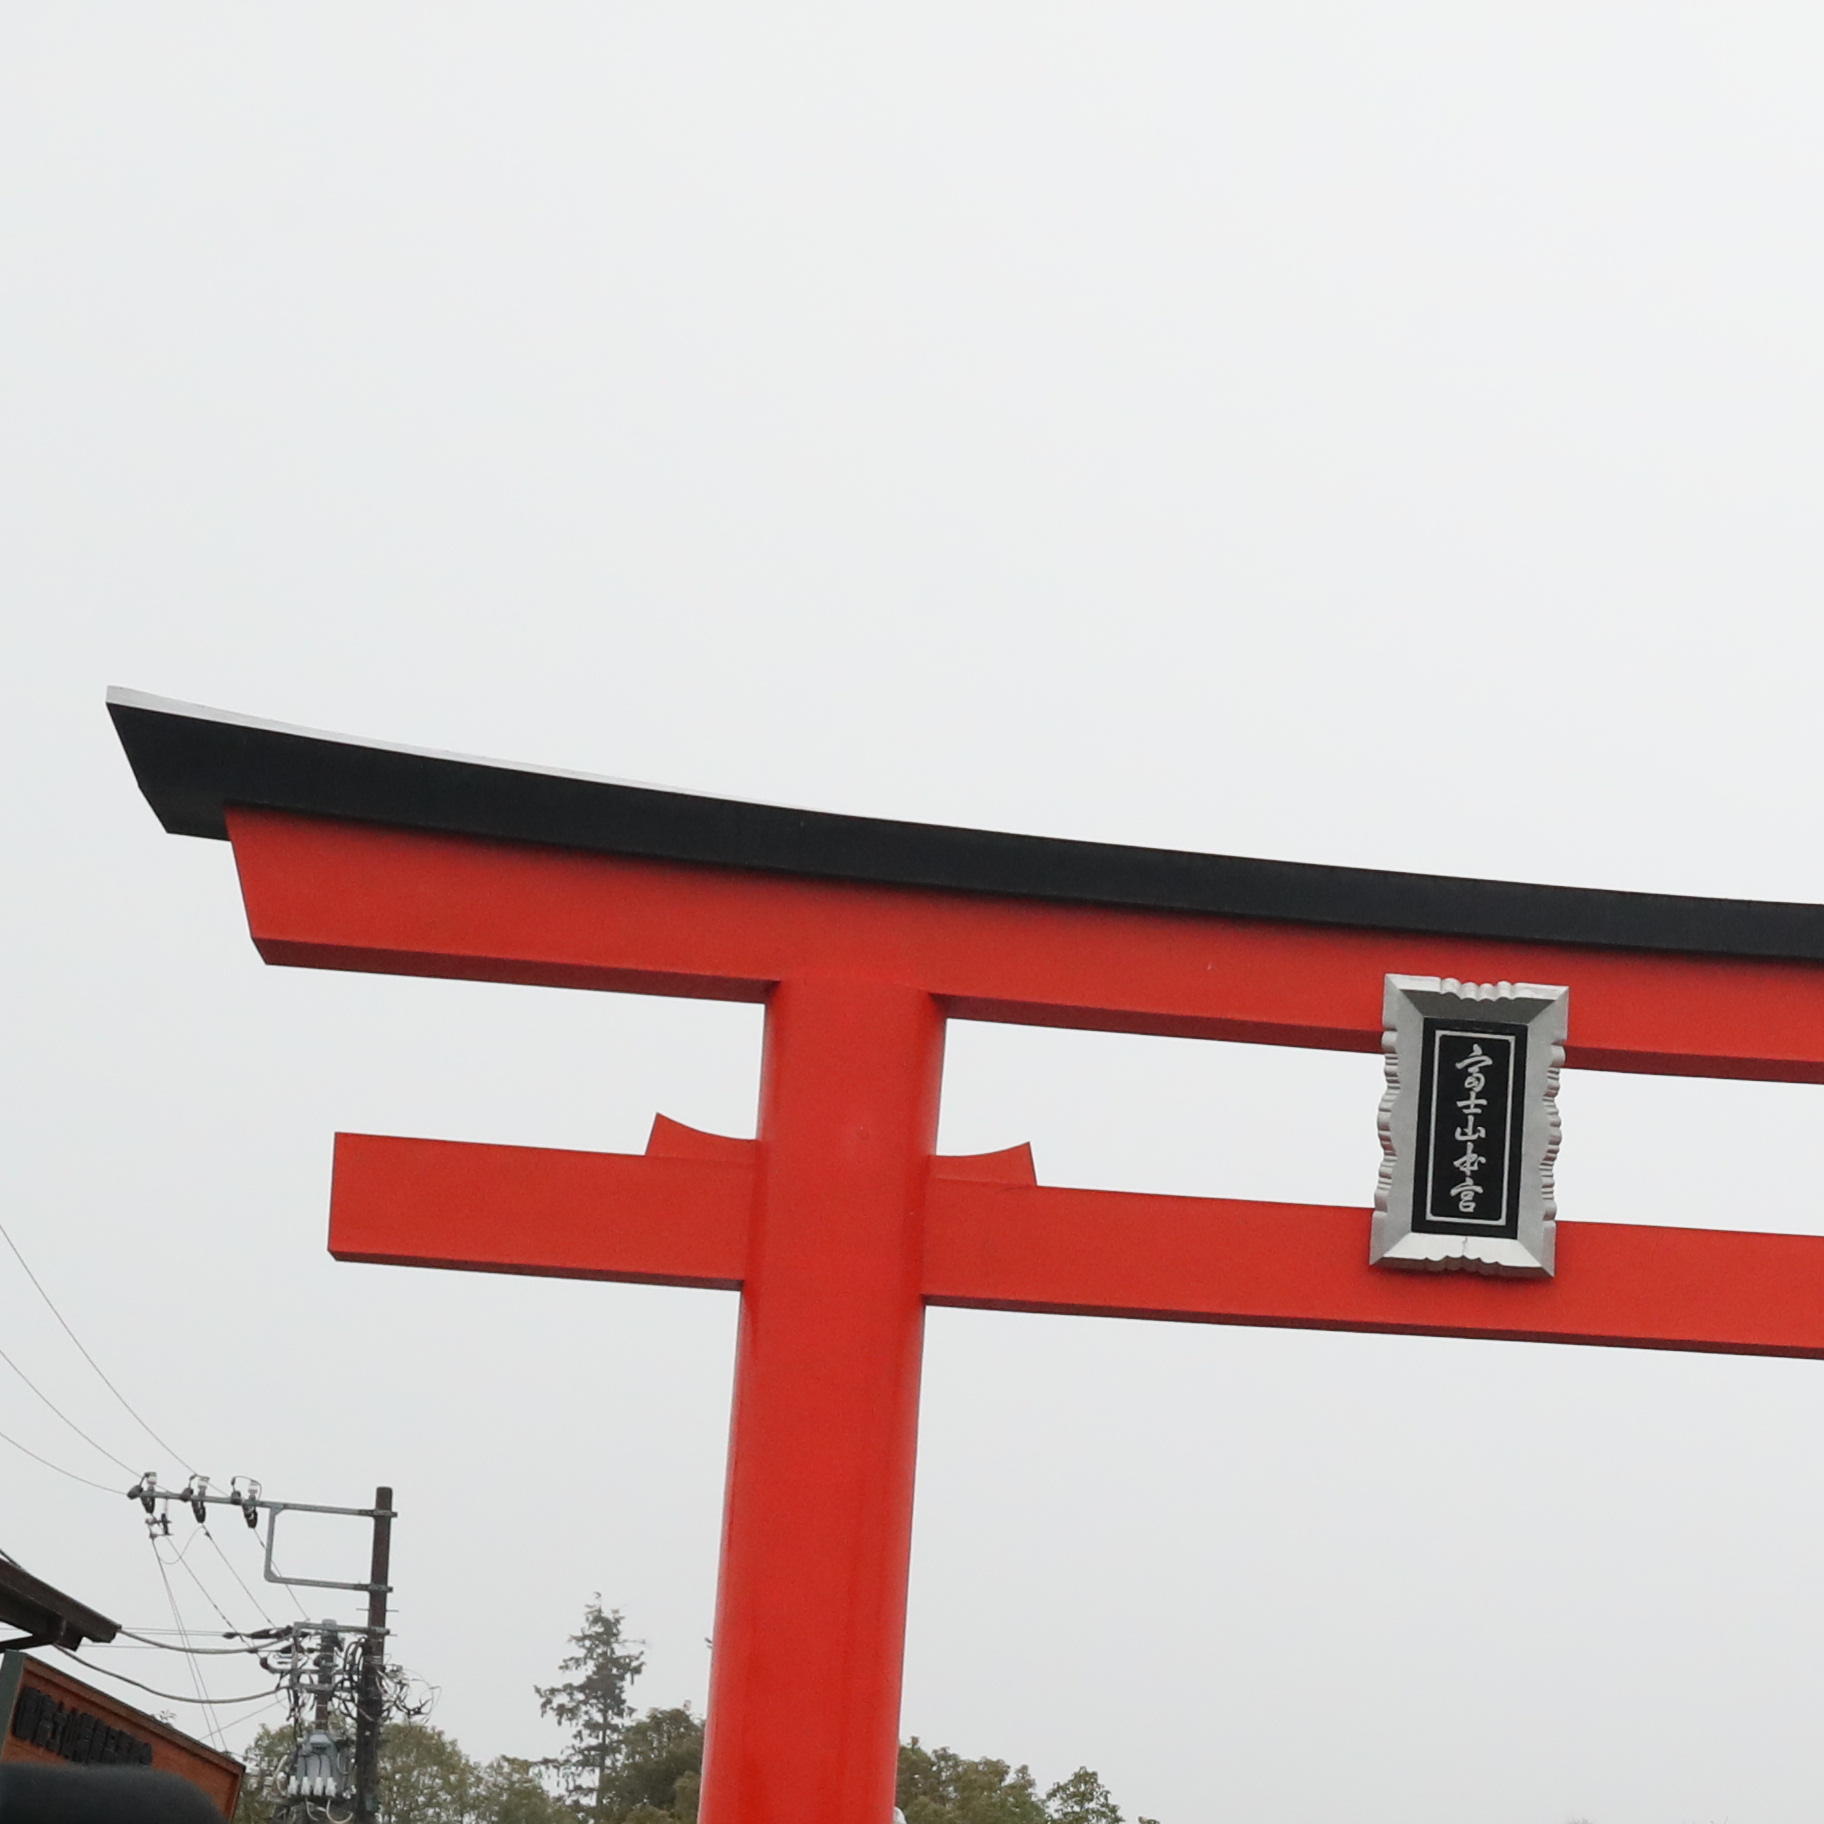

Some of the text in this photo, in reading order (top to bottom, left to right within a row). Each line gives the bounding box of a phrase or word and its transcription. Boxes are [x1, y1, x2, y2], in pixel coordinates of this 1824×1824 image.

[1450, 1043, 1493, 1213] 富士山本宮
